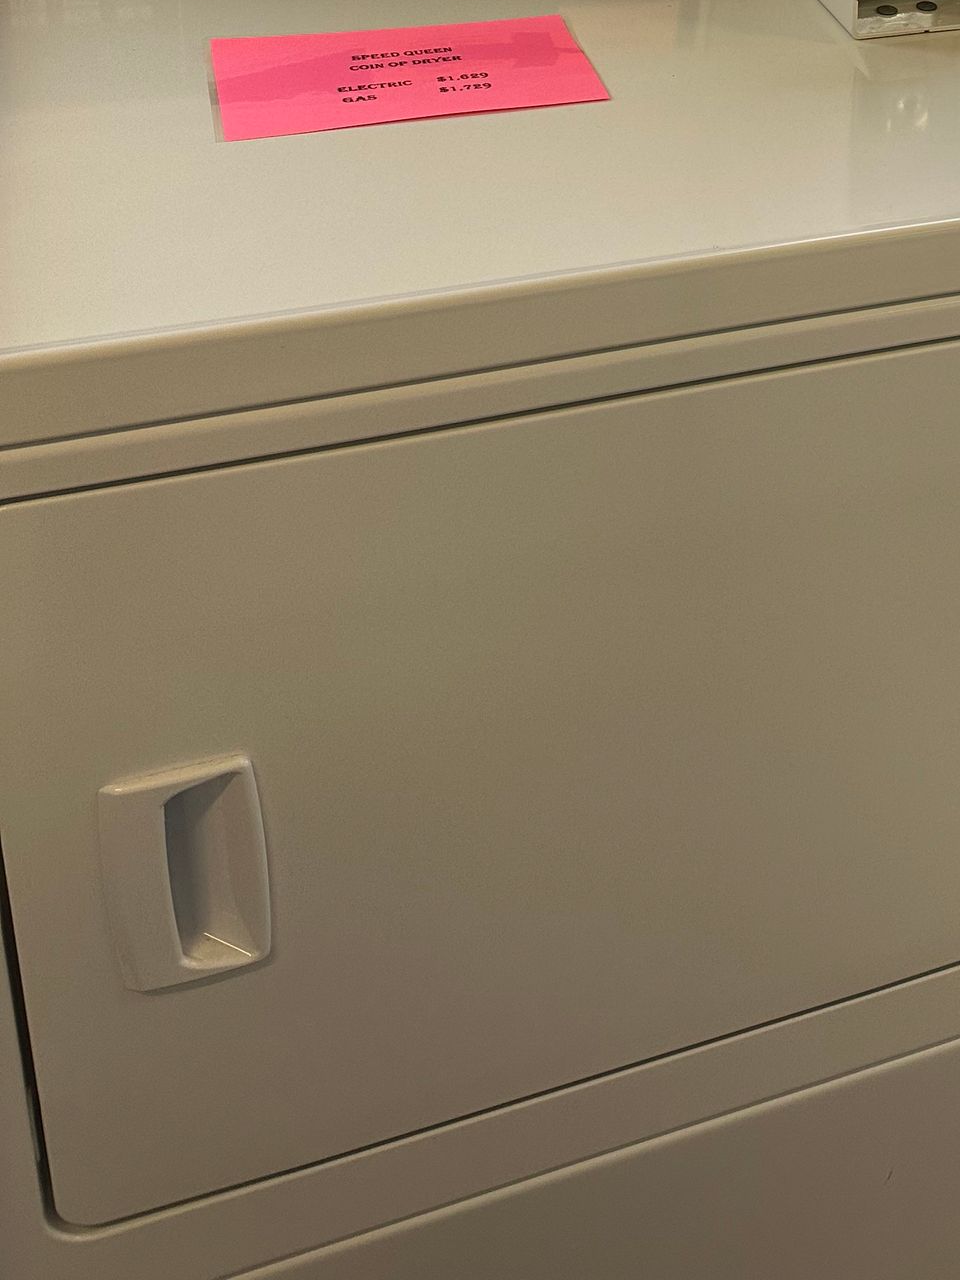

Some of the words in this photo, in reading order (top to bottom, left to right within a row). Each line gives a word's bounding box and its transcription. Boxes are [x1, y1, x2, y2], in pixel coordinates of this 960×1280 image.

[351, 51, 400, 62] SPEED
[403, 47, 453, 58] QUEEN
[349, 62, 385, 72] COIN
[388, 60, 409, 69] OP
[413, 55, 463, 66] DRYER
[337, 80, 413, 94] ELECTRIC
[342, 94, 378, 104] GAS
